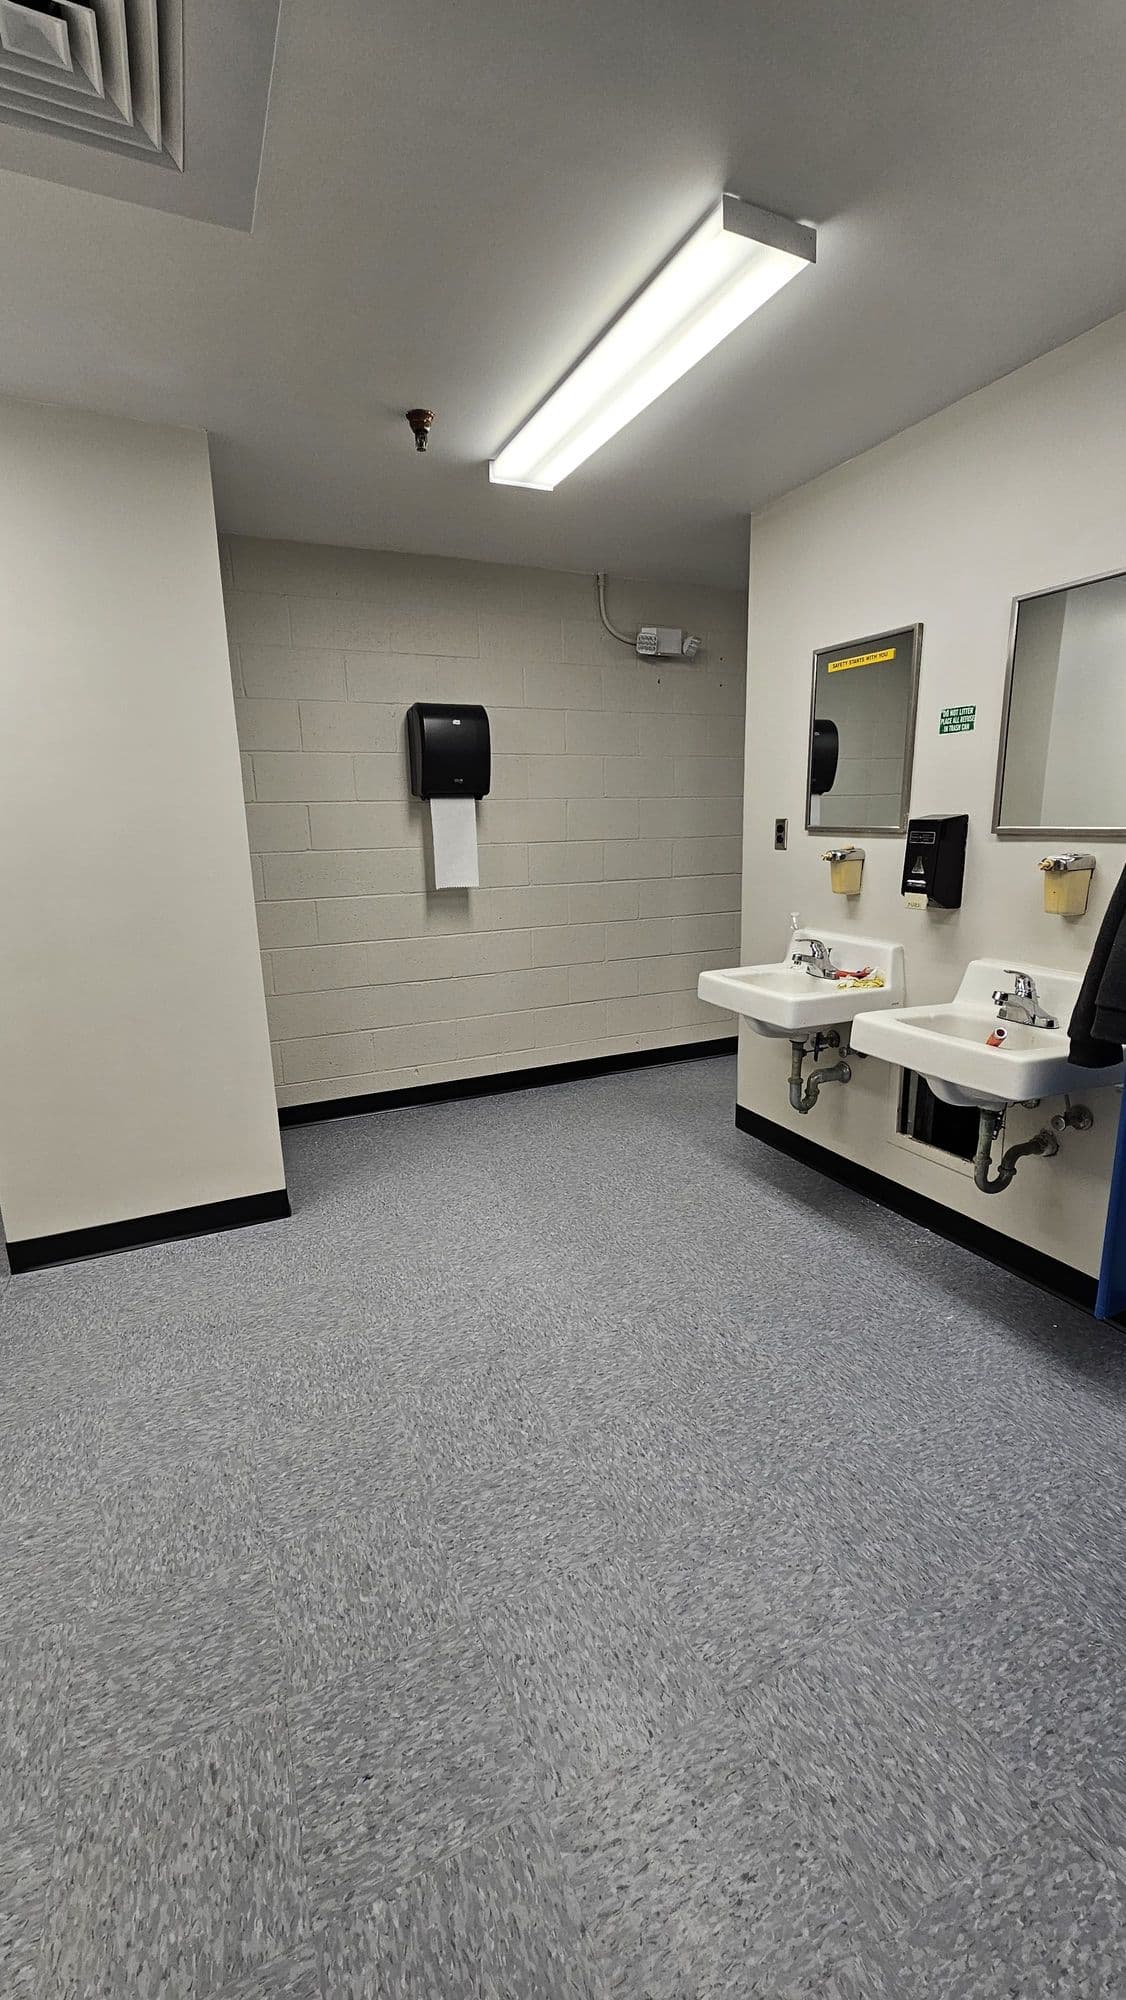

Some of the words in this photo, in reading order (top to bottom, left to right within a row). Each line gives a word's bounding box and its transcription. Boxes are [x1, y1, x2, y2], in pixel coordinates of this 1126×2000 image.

[849, 657, 864, 665] STARTS
[943, 709, 950, 717] DO
[950, 709, 959, 717] NOT
[960, 707, 974, 715] LITTER
